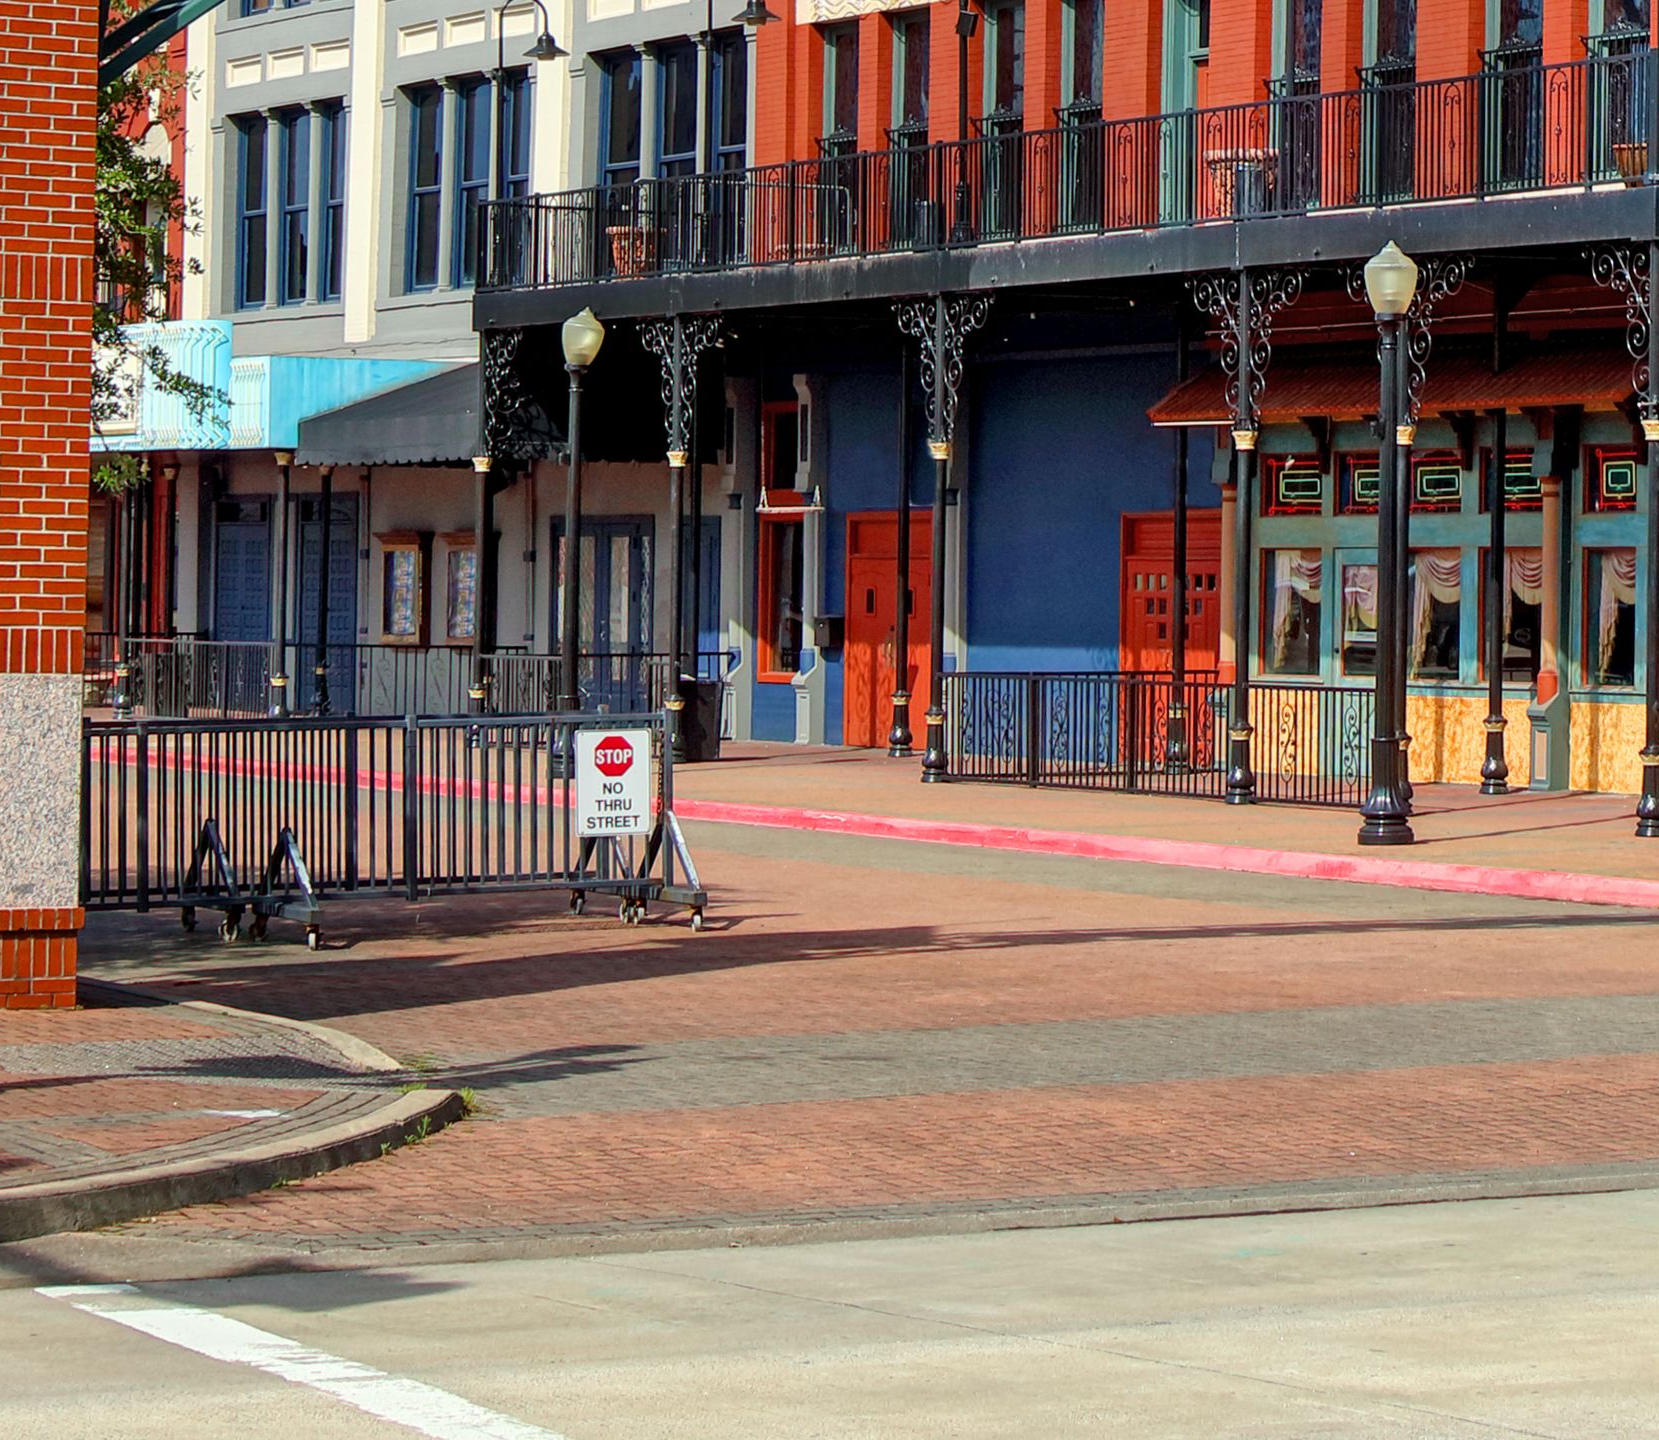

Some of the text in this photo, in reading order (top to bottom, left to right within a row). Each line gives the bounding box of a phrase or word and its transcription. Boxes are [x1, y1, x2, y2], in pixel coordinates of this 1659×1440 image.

[595, 748, 632, 765] STOP
[602, 781, 624, 795] NO
[594, 797, 633, 812] THRU
[586, 814, 641, 830] STREET
